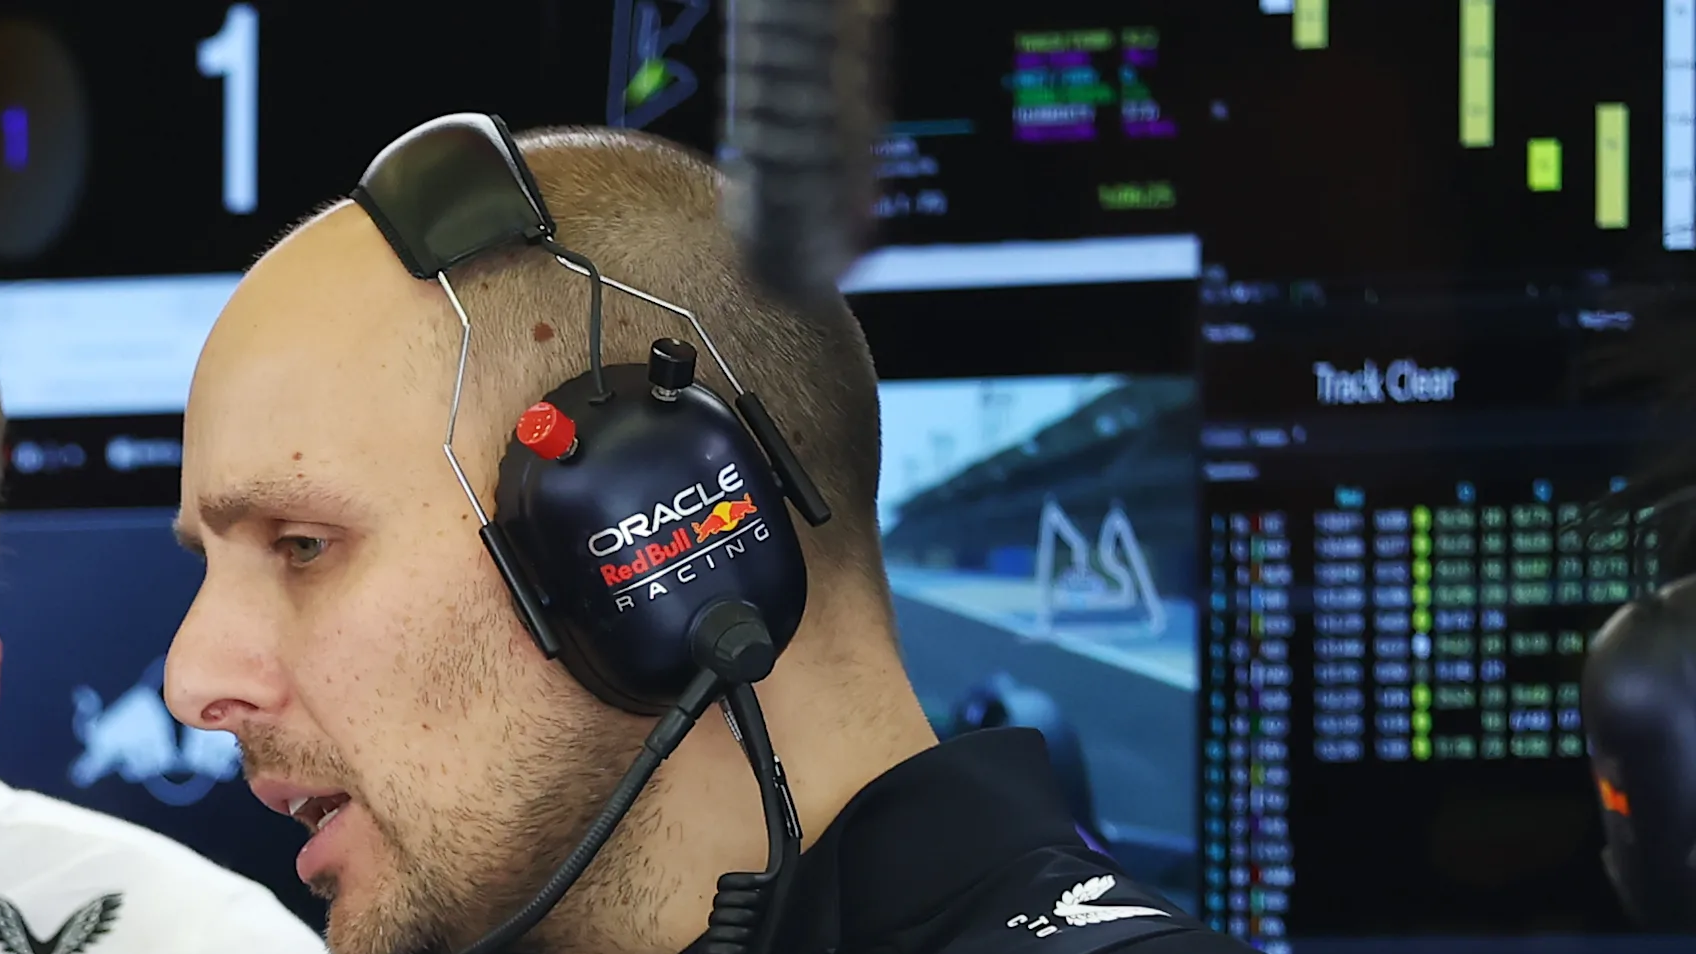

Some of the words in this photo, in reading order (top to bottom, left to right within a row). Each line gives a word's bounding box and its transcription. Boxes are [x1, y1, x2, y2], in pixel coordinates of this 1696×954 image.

[196, 2, 259, 215] 1
[1312, 359, 1384, 404] Track
[1384, 358, 1459, 402] Clear
[587, 462, 744, 557] ORACLE
[599, 549, 650, 587] Red
[645, 527, 693, 567] Bull
[615, 522, 771, 613] RACING
